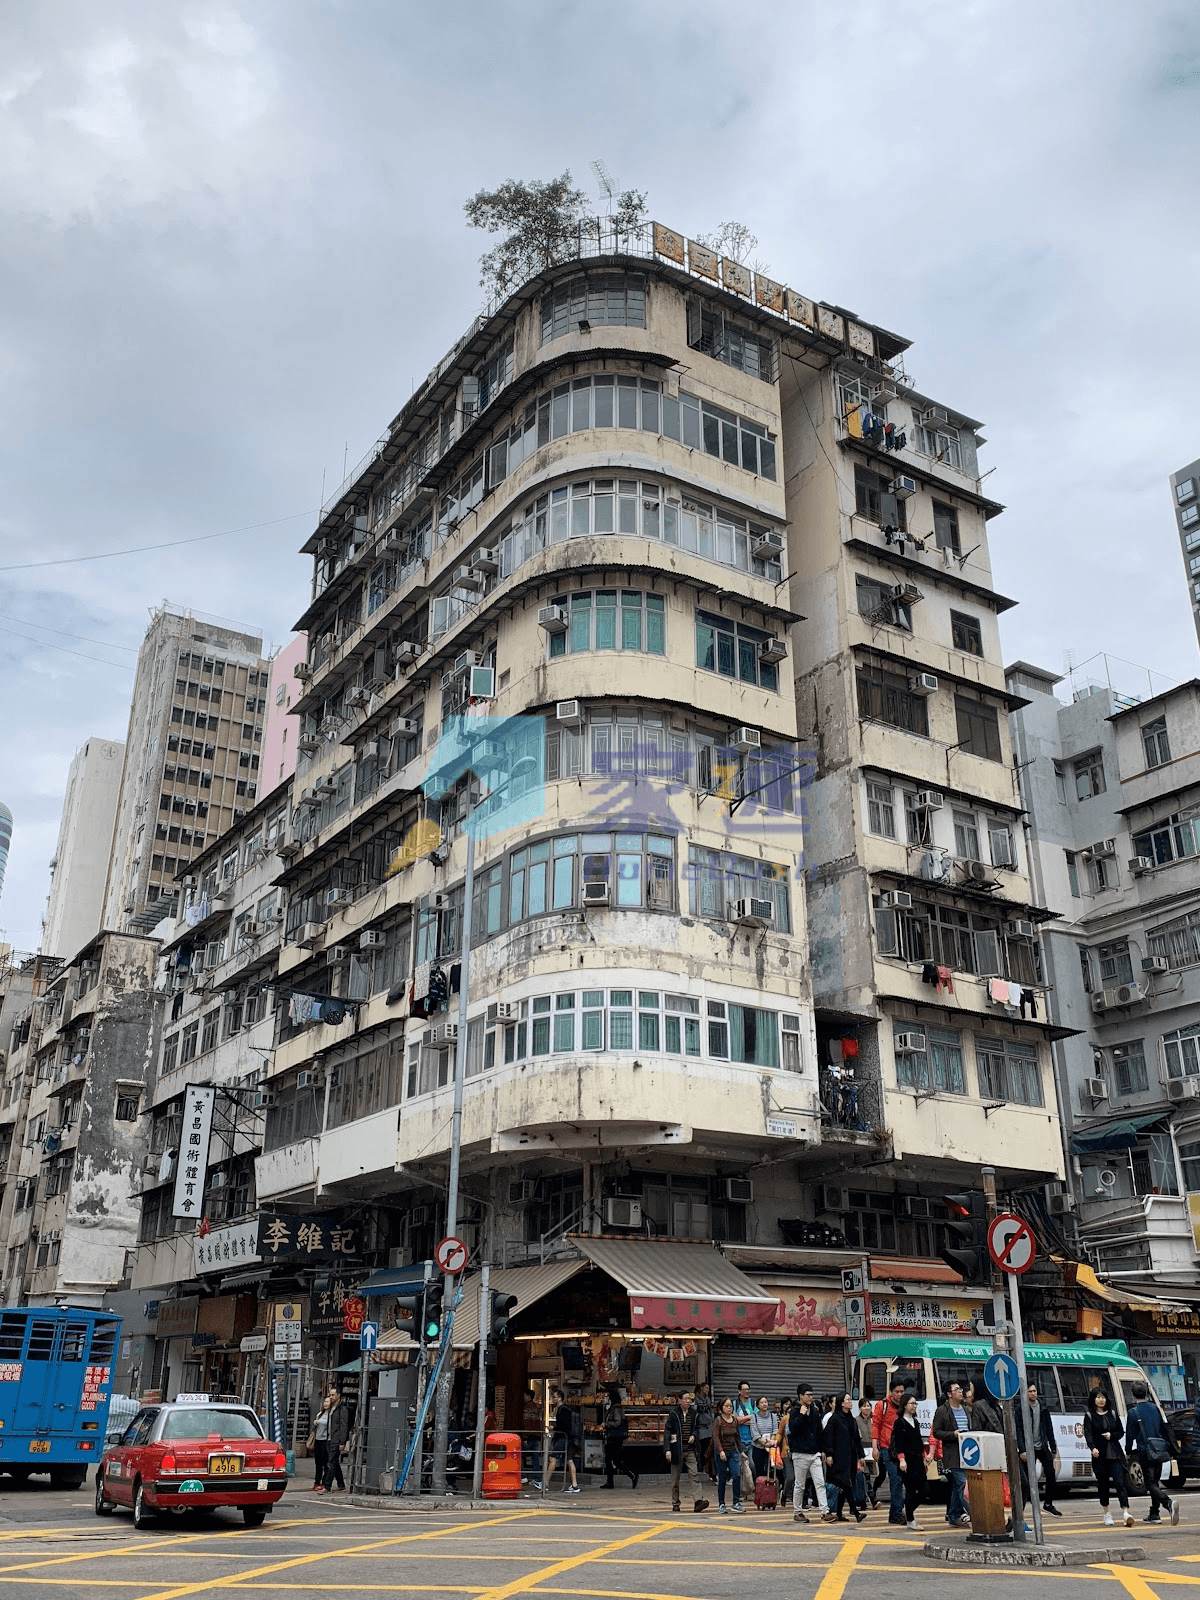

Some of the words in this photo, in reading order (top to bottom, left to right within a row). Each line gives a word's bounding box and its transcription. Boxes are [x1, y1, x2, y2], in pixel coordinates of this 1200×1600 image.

[262, 1218, 357, 1255] 李維記
[899, 1318, 931, 1327] SEAFOOD
[81, 1401, 96, 1410] GOODS
[215, 1465, 236, 1473] 4918
